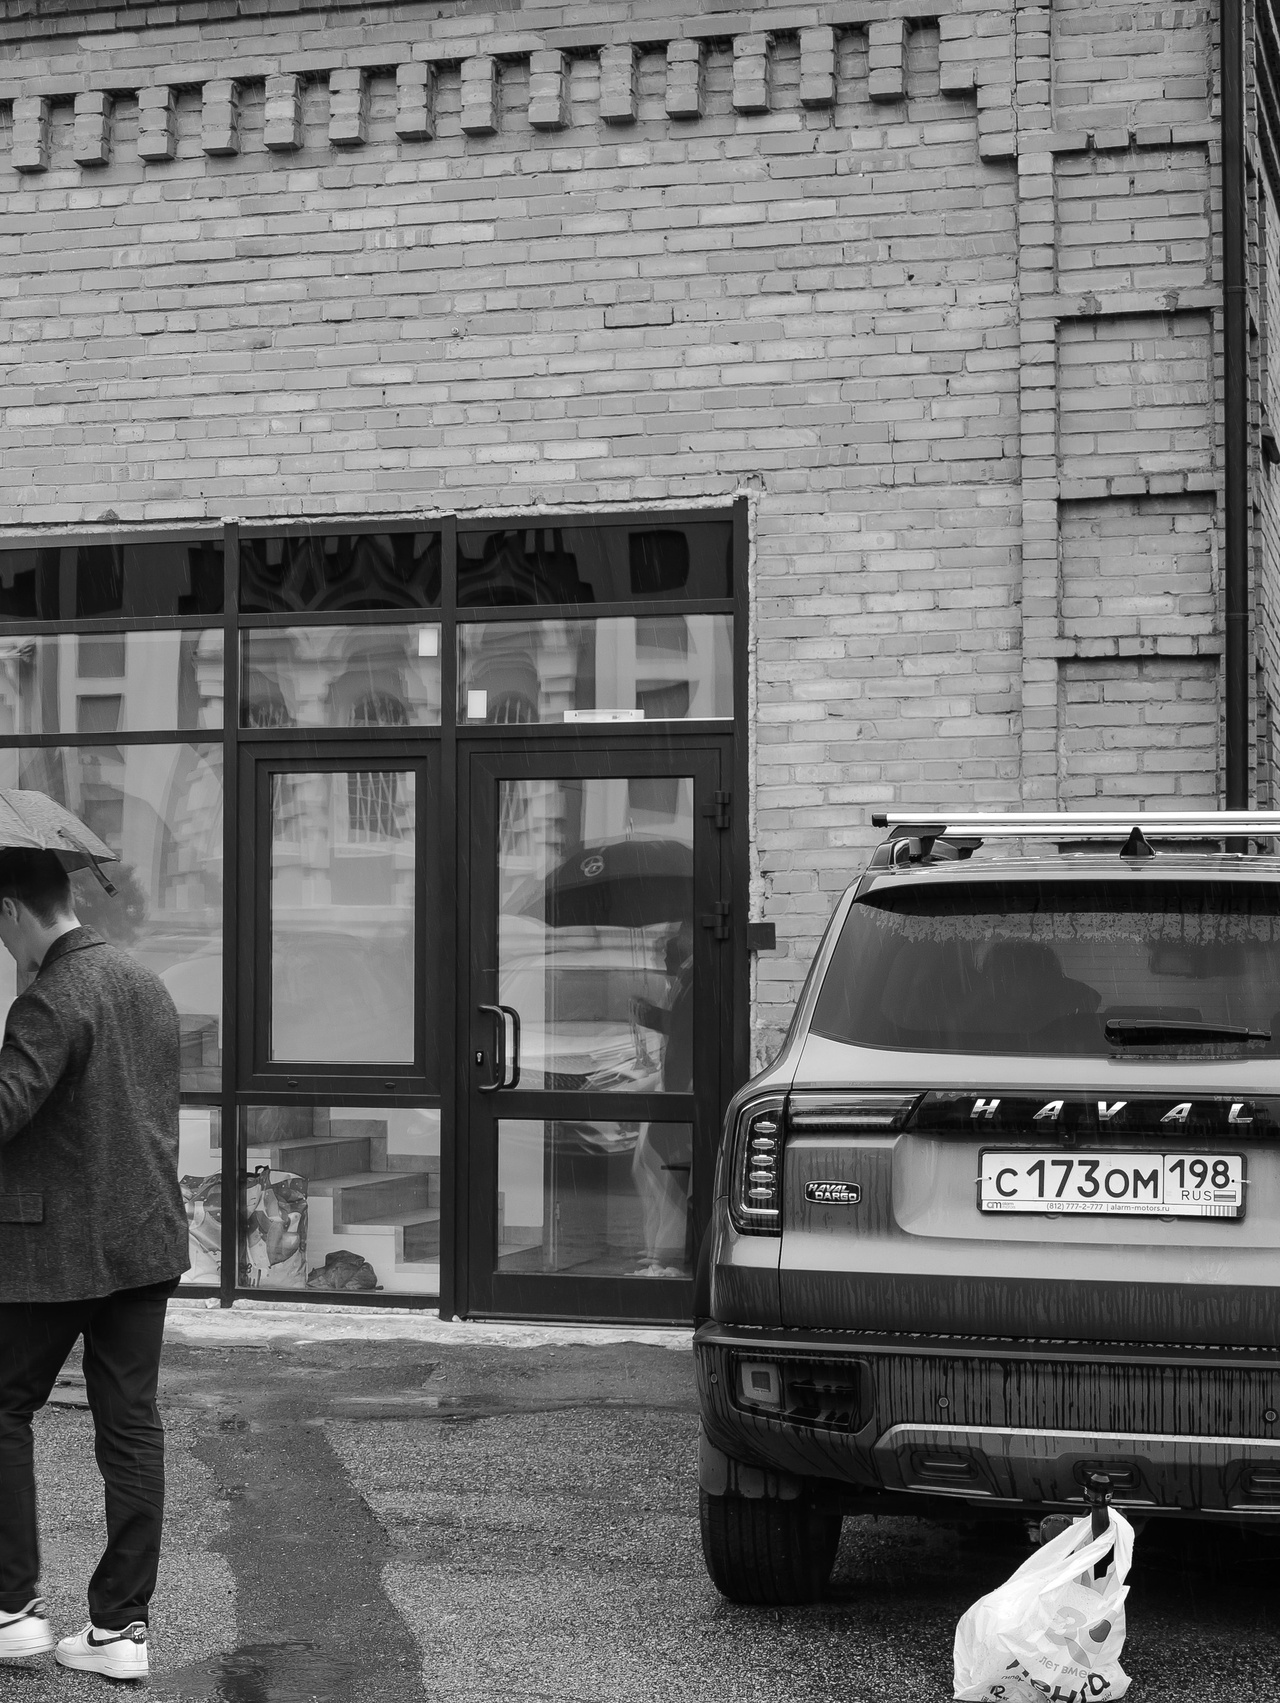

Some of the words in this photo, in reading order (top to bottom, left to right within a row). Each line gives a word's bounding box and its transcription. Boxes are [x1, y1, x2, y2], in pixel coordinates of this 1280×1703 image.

[970, 1099, 1253, 1123] HAVAL
[1168, 1159, 1231, 1189] 198
[808, 1184, 849, 1192] HAVAL
[815, 1192, 857, 1200] DARGO
[1181, 1190, 1212, 1201] RUS
[1046, 1202, 1065, 1211] (812)
[1065, 1203, 1104, 1211] 777-2-777
[1110, 1204, 1170, 1213] alarm-motors.ru
[1038, 1656, 1060, 1672] лет
[1061, 1667, 1089, 1679] вме
